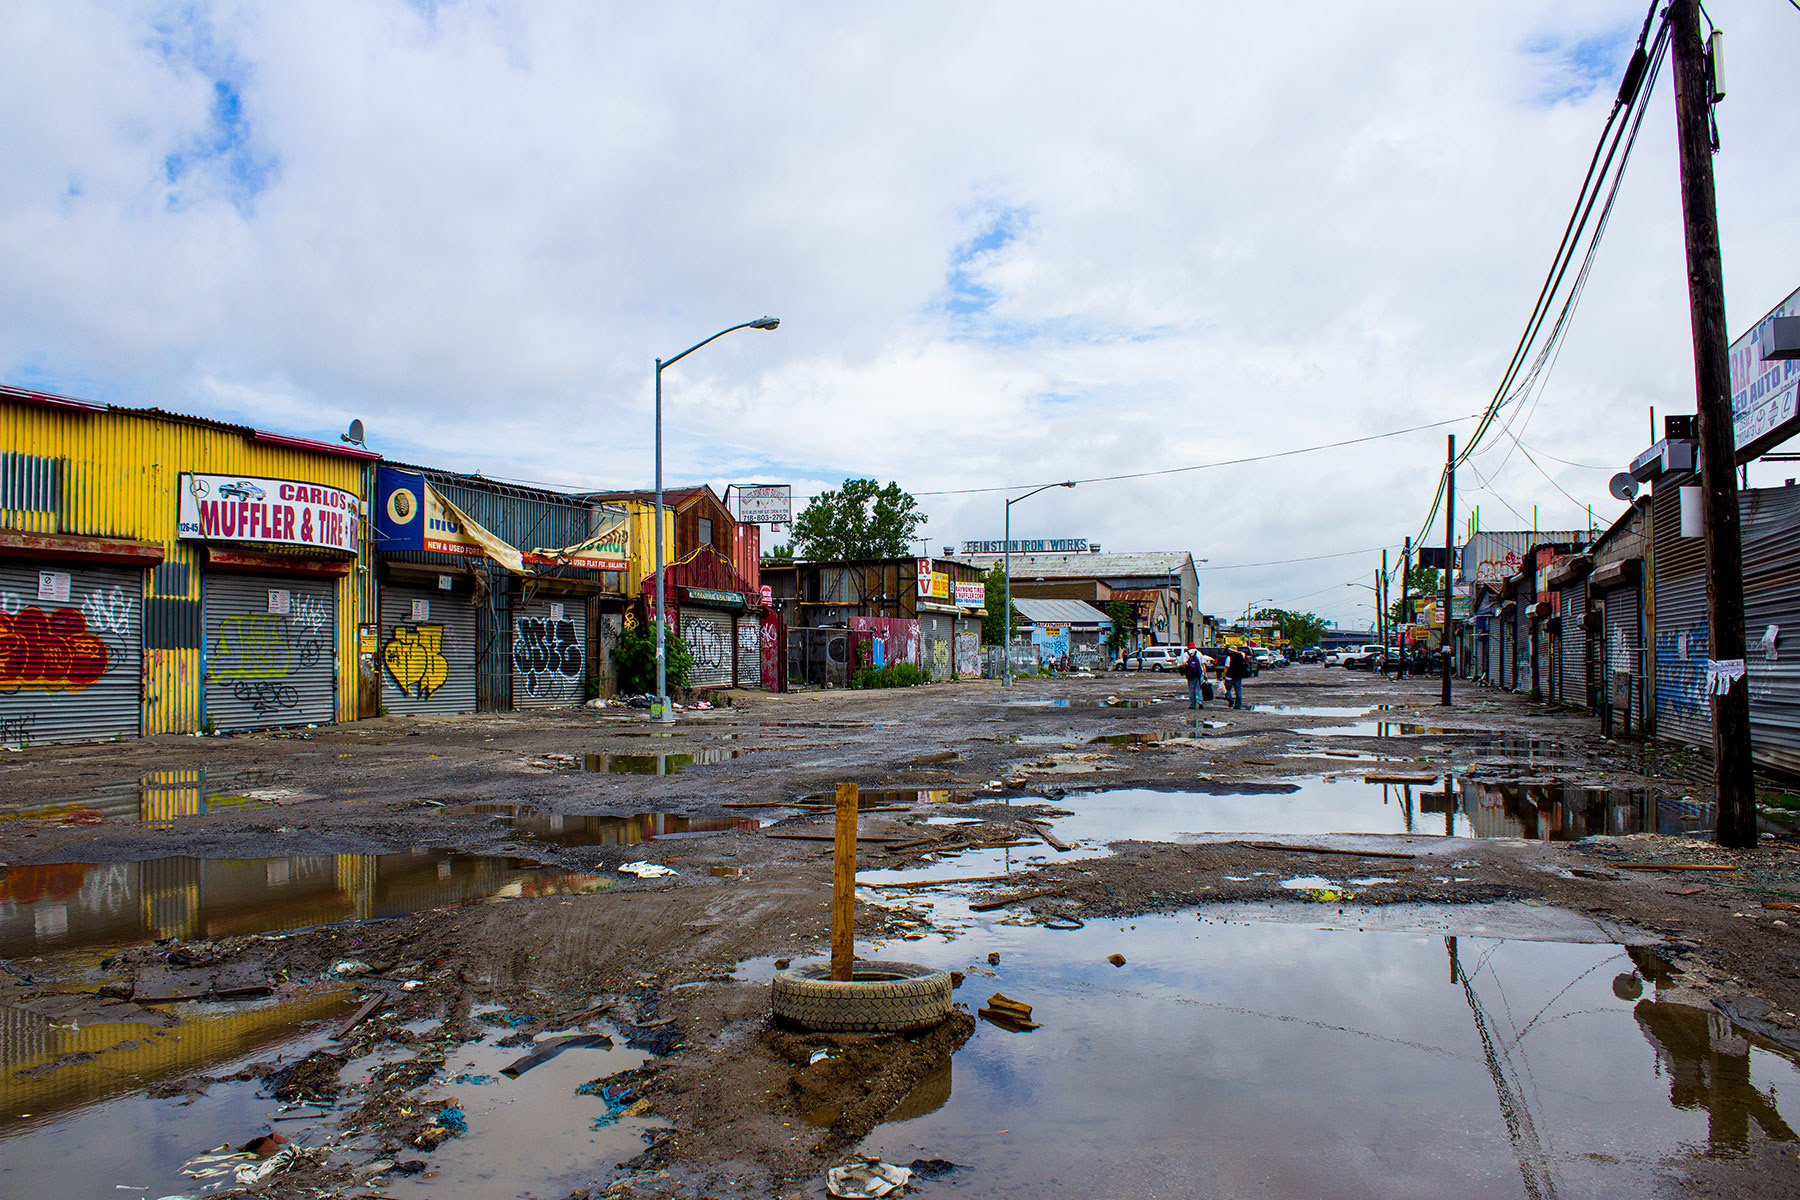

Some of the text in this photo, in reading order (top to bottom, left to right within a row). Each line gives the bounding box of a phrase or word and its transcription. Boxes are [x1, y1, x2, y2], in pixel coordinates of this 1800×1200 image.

[1750, 365, 1780, 404] AUTO
[280, 484, 347, 510] CARLO'S
[179, 522, 198, 532] 126-45
[198, 500, 295, 540] MUFFLER
[301, 507, 314, 542] &
[318, 509, 344, 546] TIRE
[428, 540, 442, 550] NEW
[443, 543, 448, 551] &
[449, 544, 465, 553] USED
[1021, 540, 1044, 552] IRON
[1050, 539, 1087, 551] WORKS
[574, 558, 586, 566] USED
